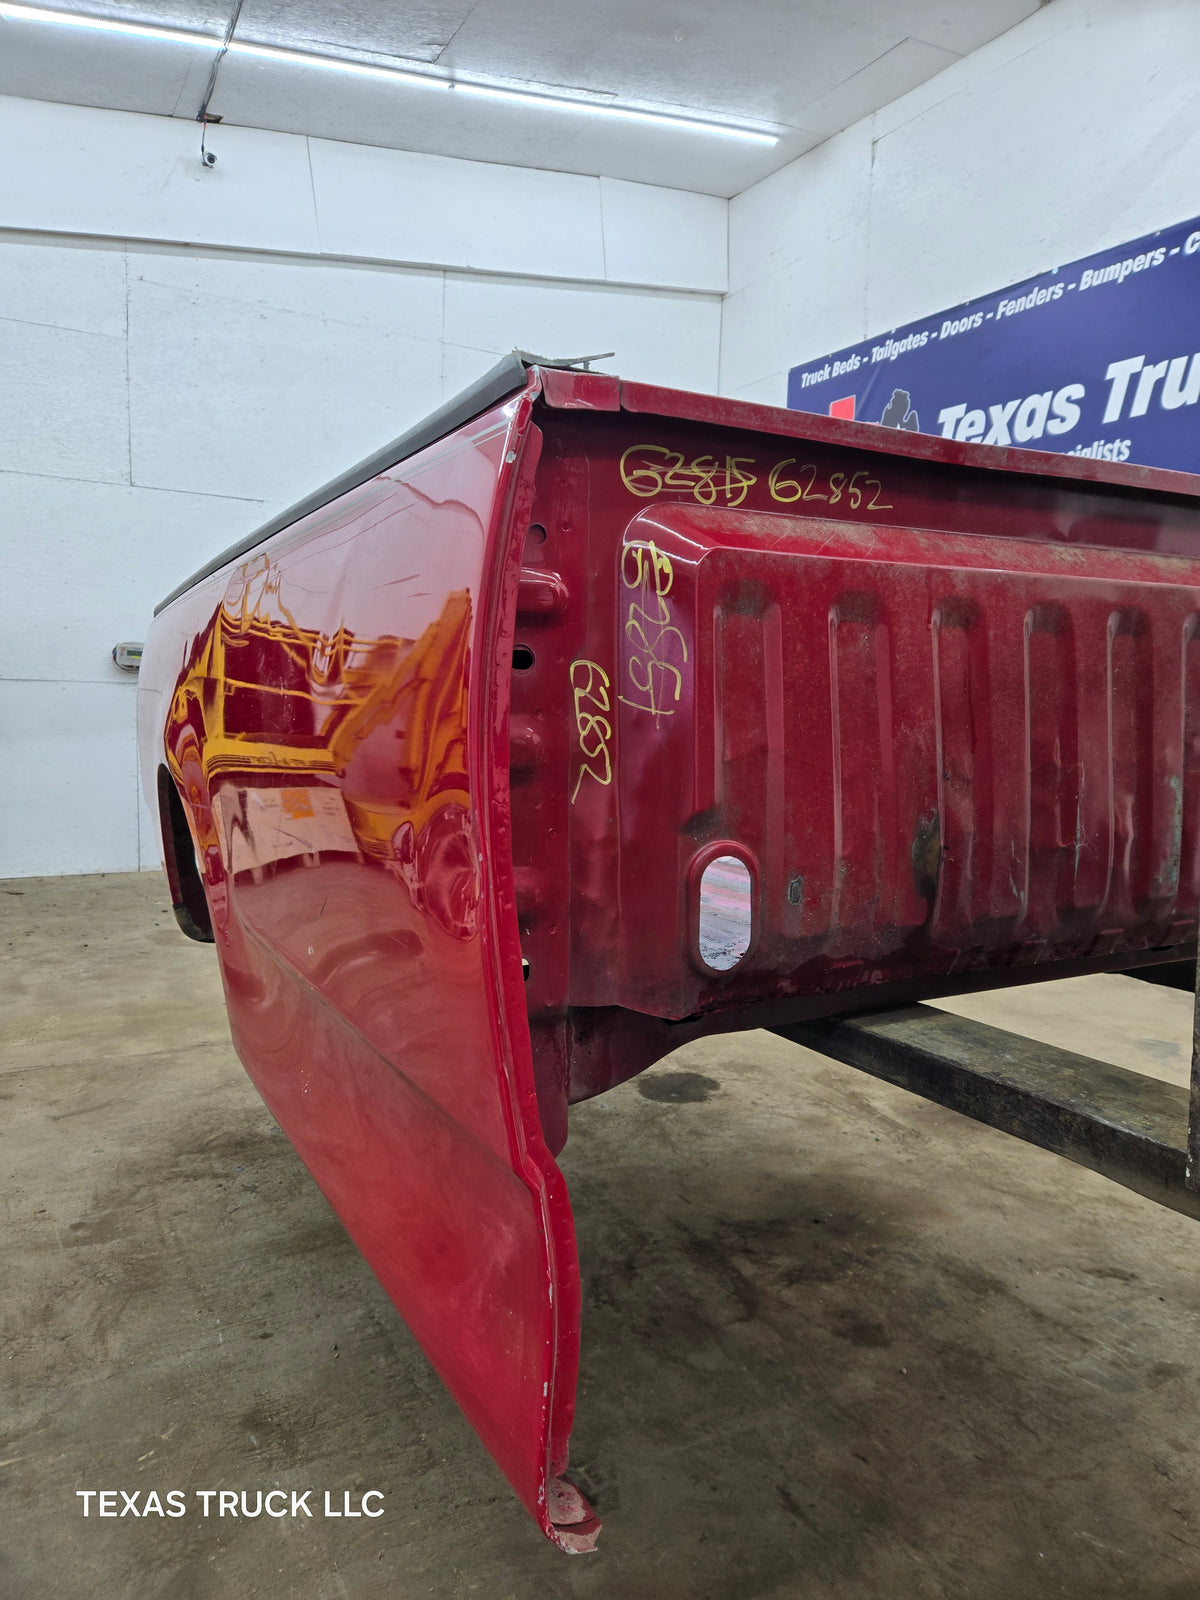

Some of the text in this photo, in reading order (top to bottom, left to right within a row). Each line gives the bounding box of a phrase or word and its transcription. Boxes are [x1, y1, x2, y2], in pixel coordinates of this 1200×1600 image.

[801, 363, 832, 388] Truck
[832, 354, 862, 378] Beds
[871, 331, 929, 360] Tailgates
[940, 311, 984, 340] Doors
[995, 282, 1066, 321] Fenders
[1078, 247, 1167, 291] Bumpers
[937, 383, 1086, 446] Texas
[768, 458, 894, 510] 62852
[569, 659, 612, 805] 62852
